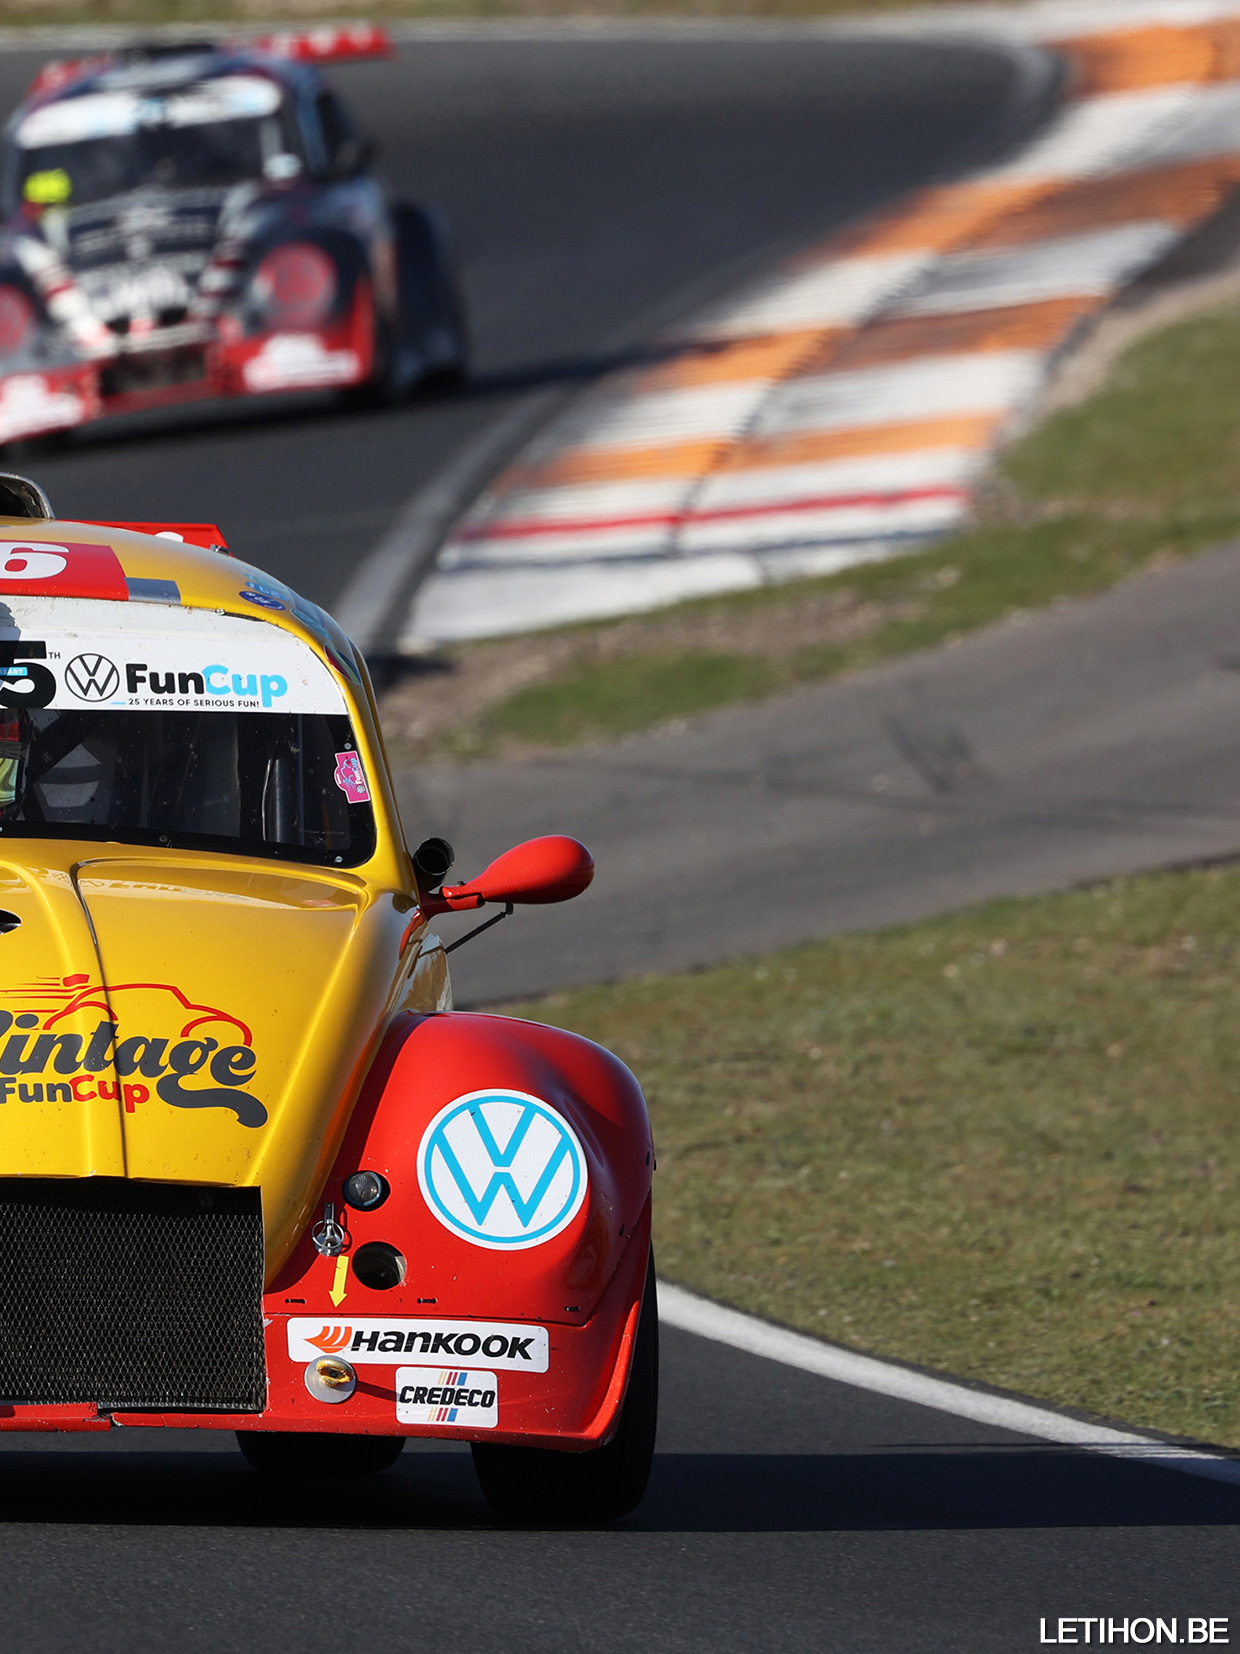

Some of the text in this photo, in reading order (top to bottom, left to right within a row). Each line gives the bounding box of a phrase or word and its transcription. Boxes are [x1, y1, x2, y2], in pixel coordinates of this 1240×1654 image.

[48, 652, 61, 660] TH
[125, 663, 288, 708] FunCup
[128, 698, 140, 706] 25
[143, 698, 174, 706] YEARS
[194, 699, 235, 708] SERIOUS
[238, 700, 260, 708] FUN!
[399, 1386, 496, 1408] CREDECO
